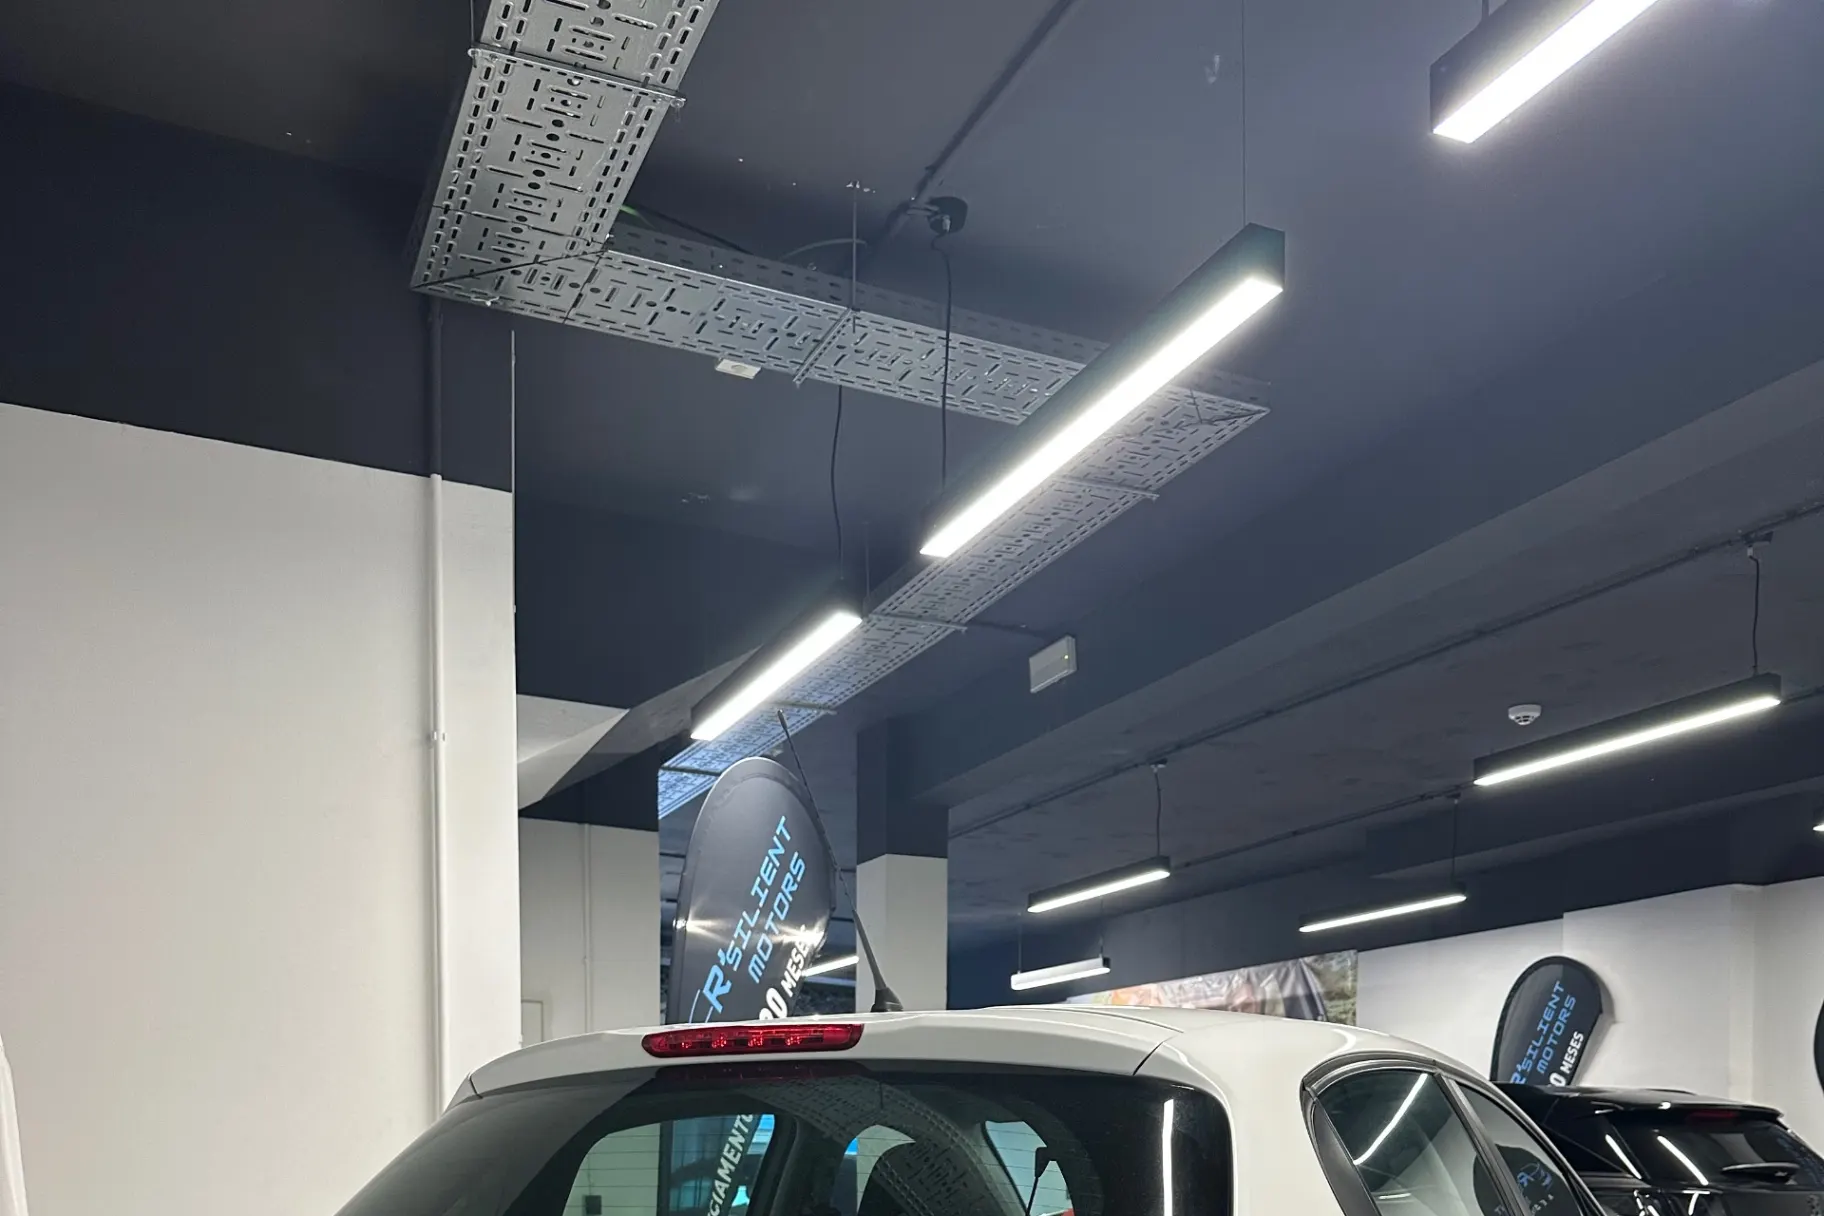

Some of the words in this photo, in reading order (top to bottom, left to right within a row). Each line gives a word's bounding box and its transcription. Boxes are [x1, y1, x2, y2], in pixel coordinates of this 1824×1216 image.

[702, 815, 791, 1014] R'SILIENT
[747, 851, 806, 984] MOTORS
[780, 924, 815, 998] MESE
[1536, 994, 1577, 1075] MOTORS
[1559, 1031, 1585, 1075] MESES
